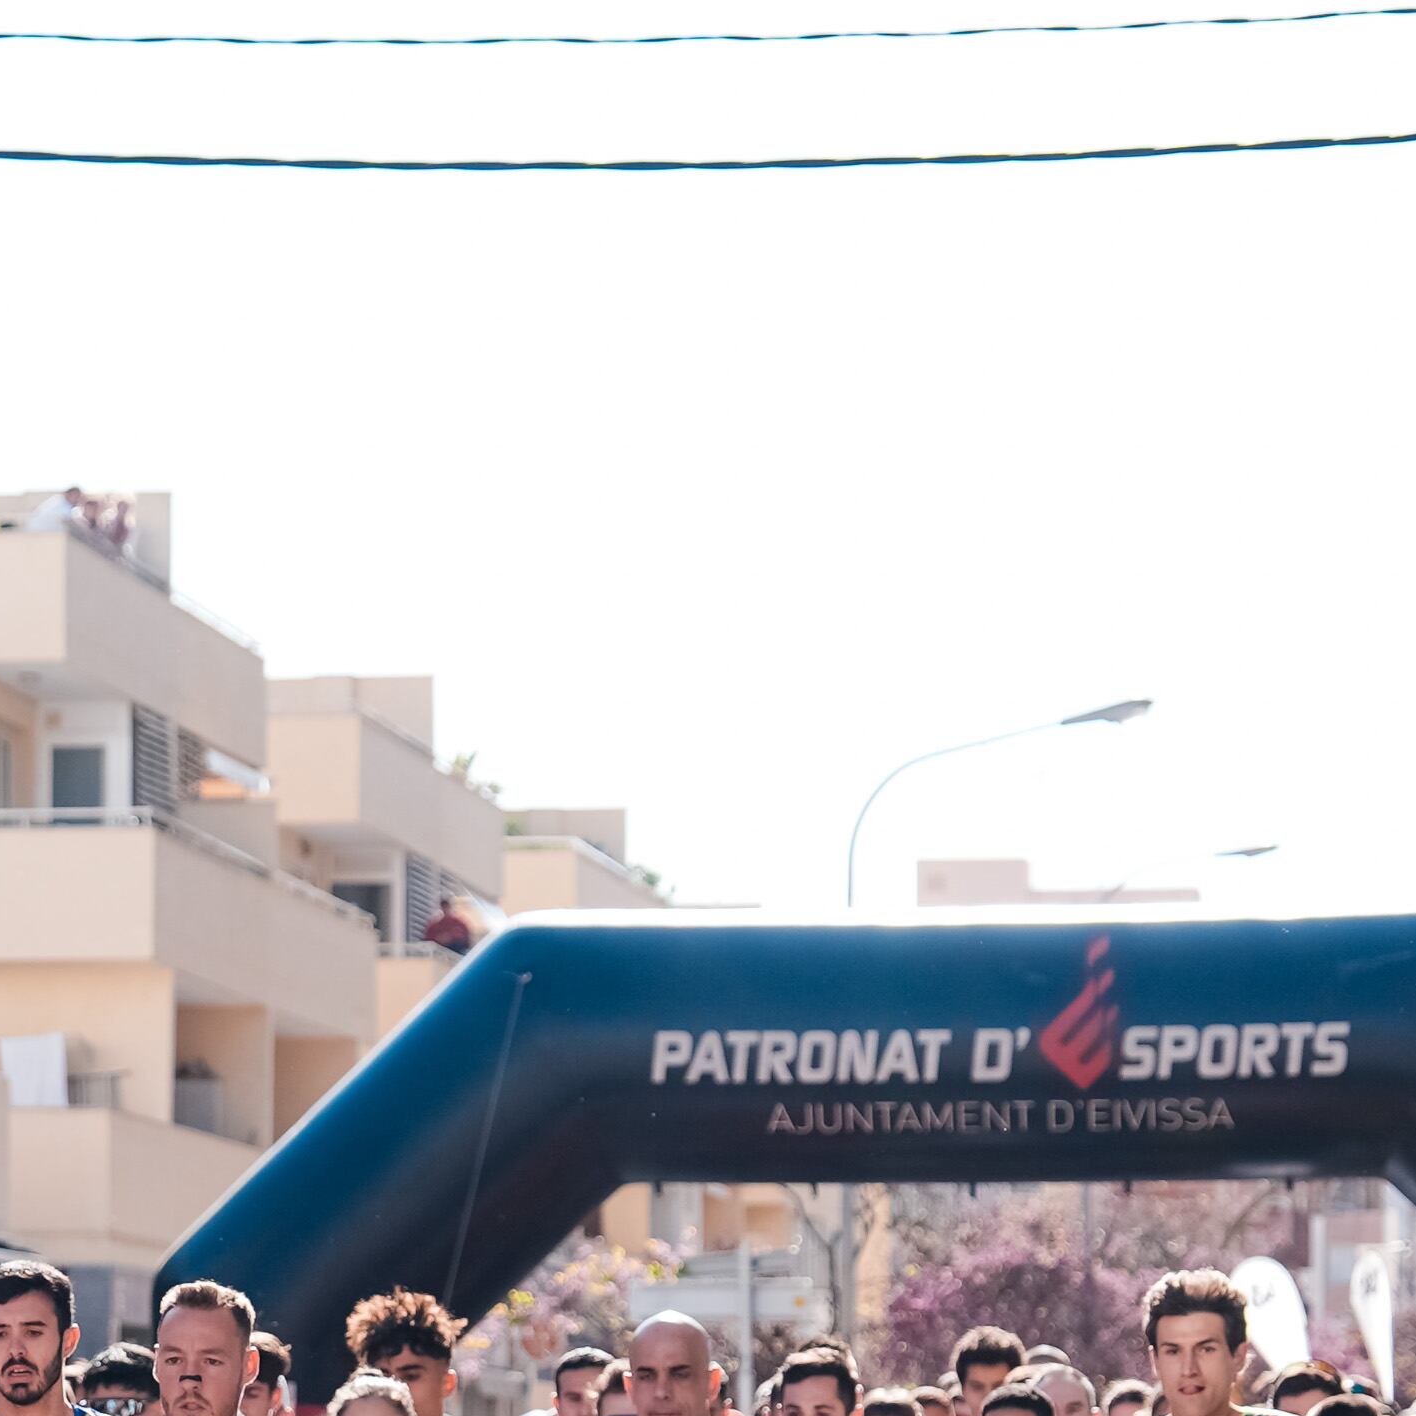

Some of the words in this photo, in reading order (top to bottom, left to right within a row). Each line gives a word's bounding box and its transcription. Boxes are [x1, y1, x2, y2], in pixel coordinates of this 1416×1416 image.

[651, 1029, 952, 1084] PATRONAT
[970, 1027, 1030, 1083] D'
[766, 1101, 1037, 1134] AJUNTAMENT
[1046, 1098, 1236, 1132] D'EIVISSA
